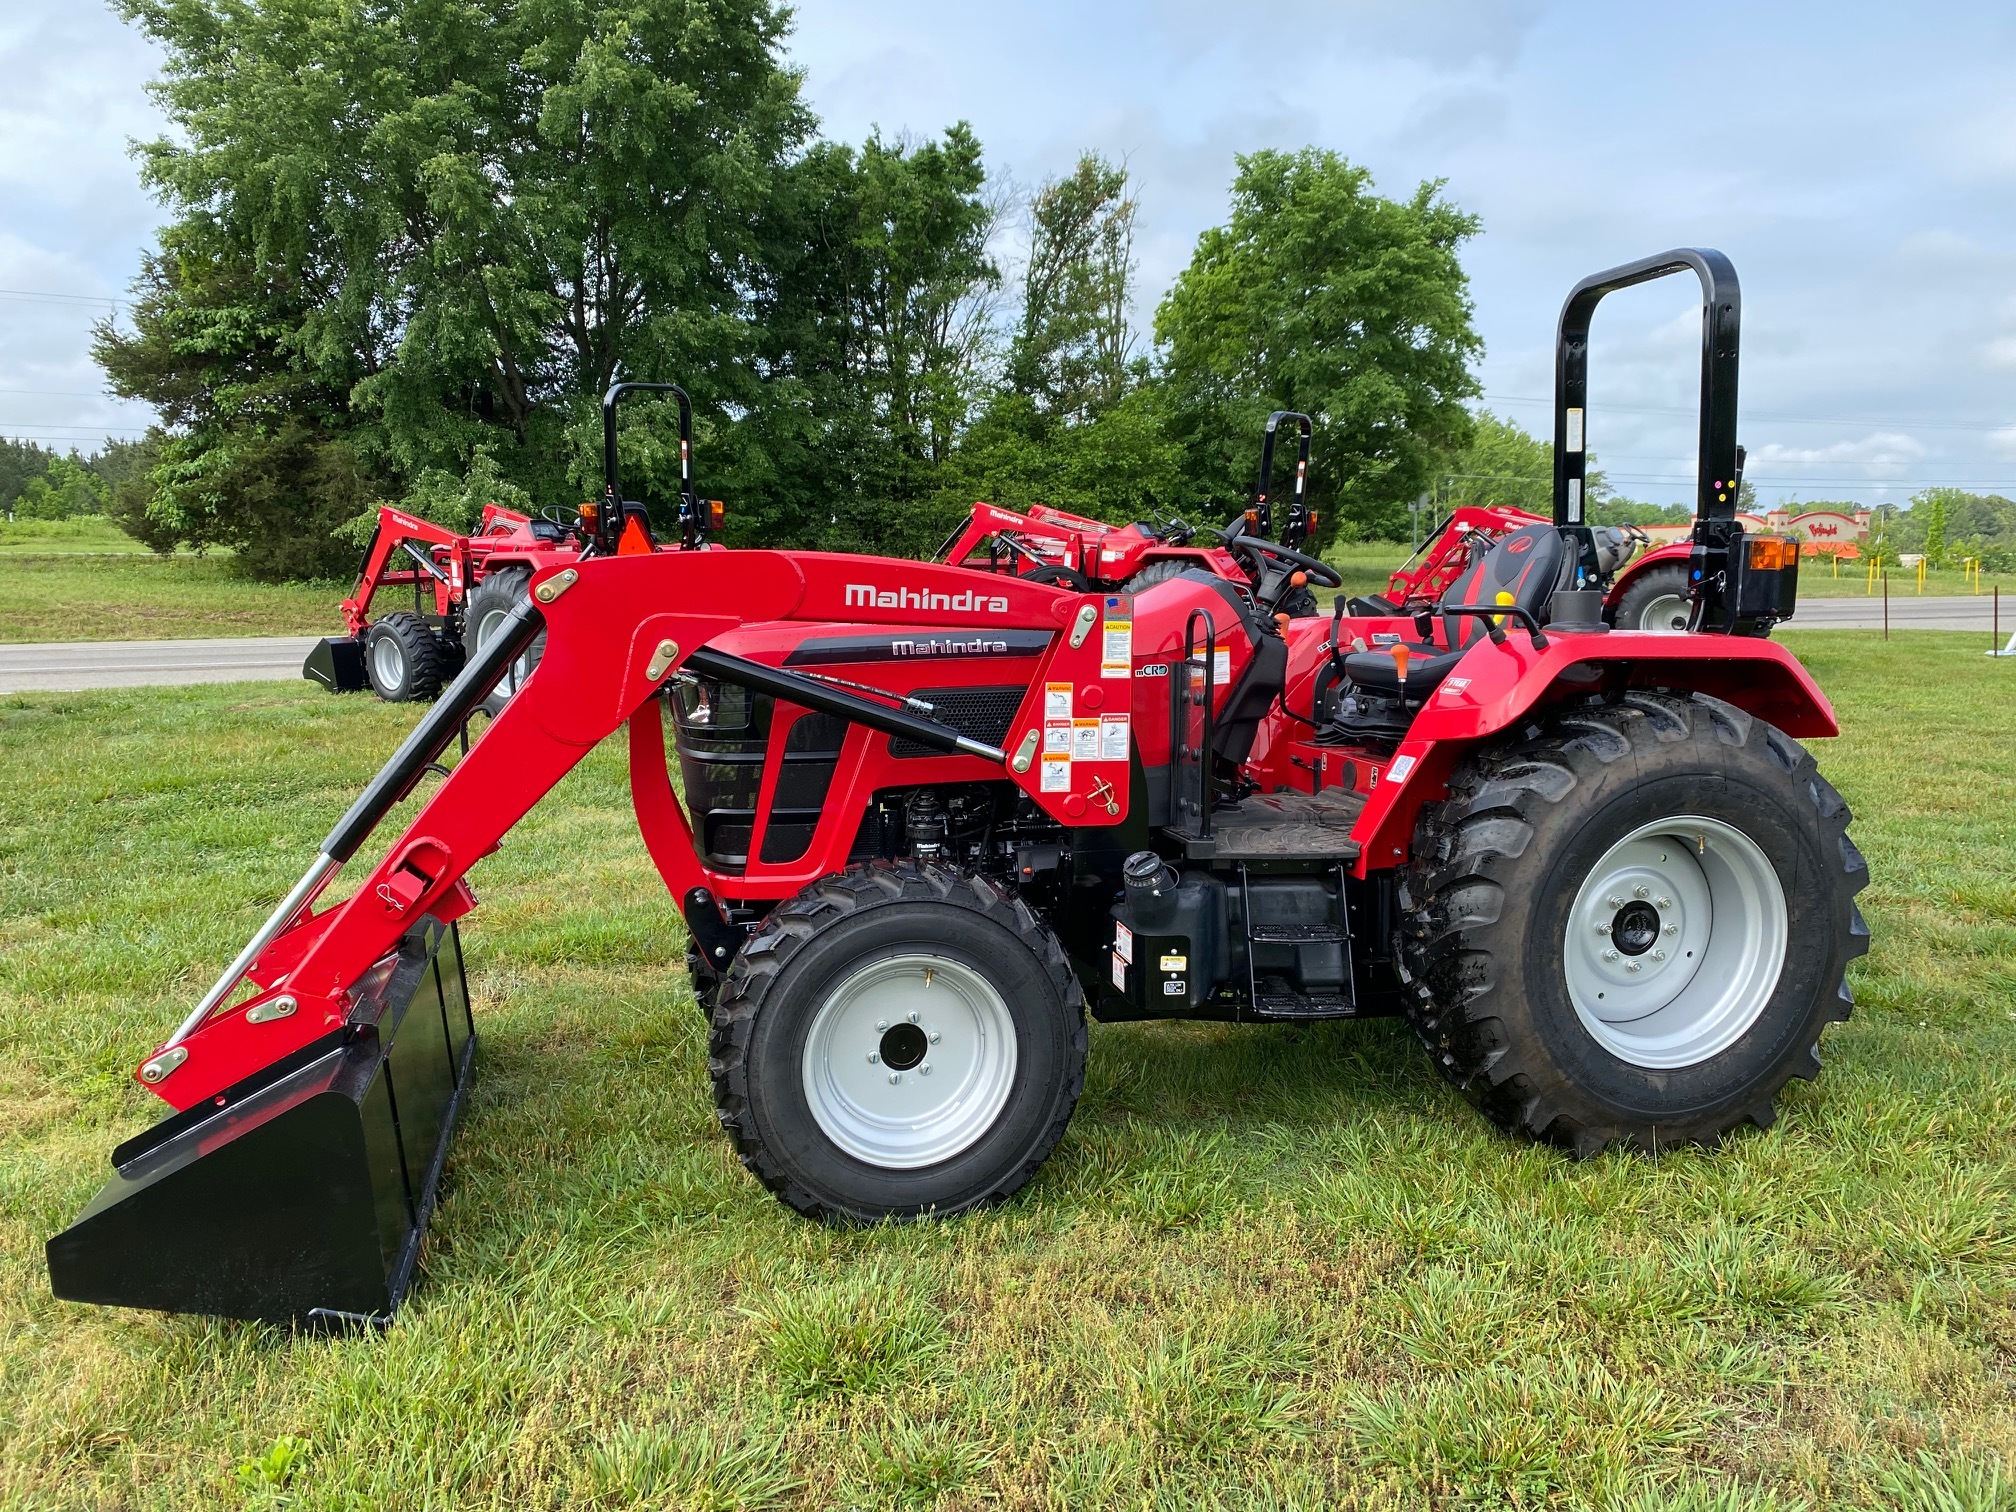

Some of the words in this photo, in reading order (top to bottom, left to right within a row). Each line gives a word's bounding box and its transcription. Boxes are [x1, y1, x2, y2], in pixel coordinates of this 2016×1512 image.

[845, 584, 1009, 613] Mahindra
[892, 638, 1008, 656] Mahindra
[1136, 665, 1168, 676] mCRD
